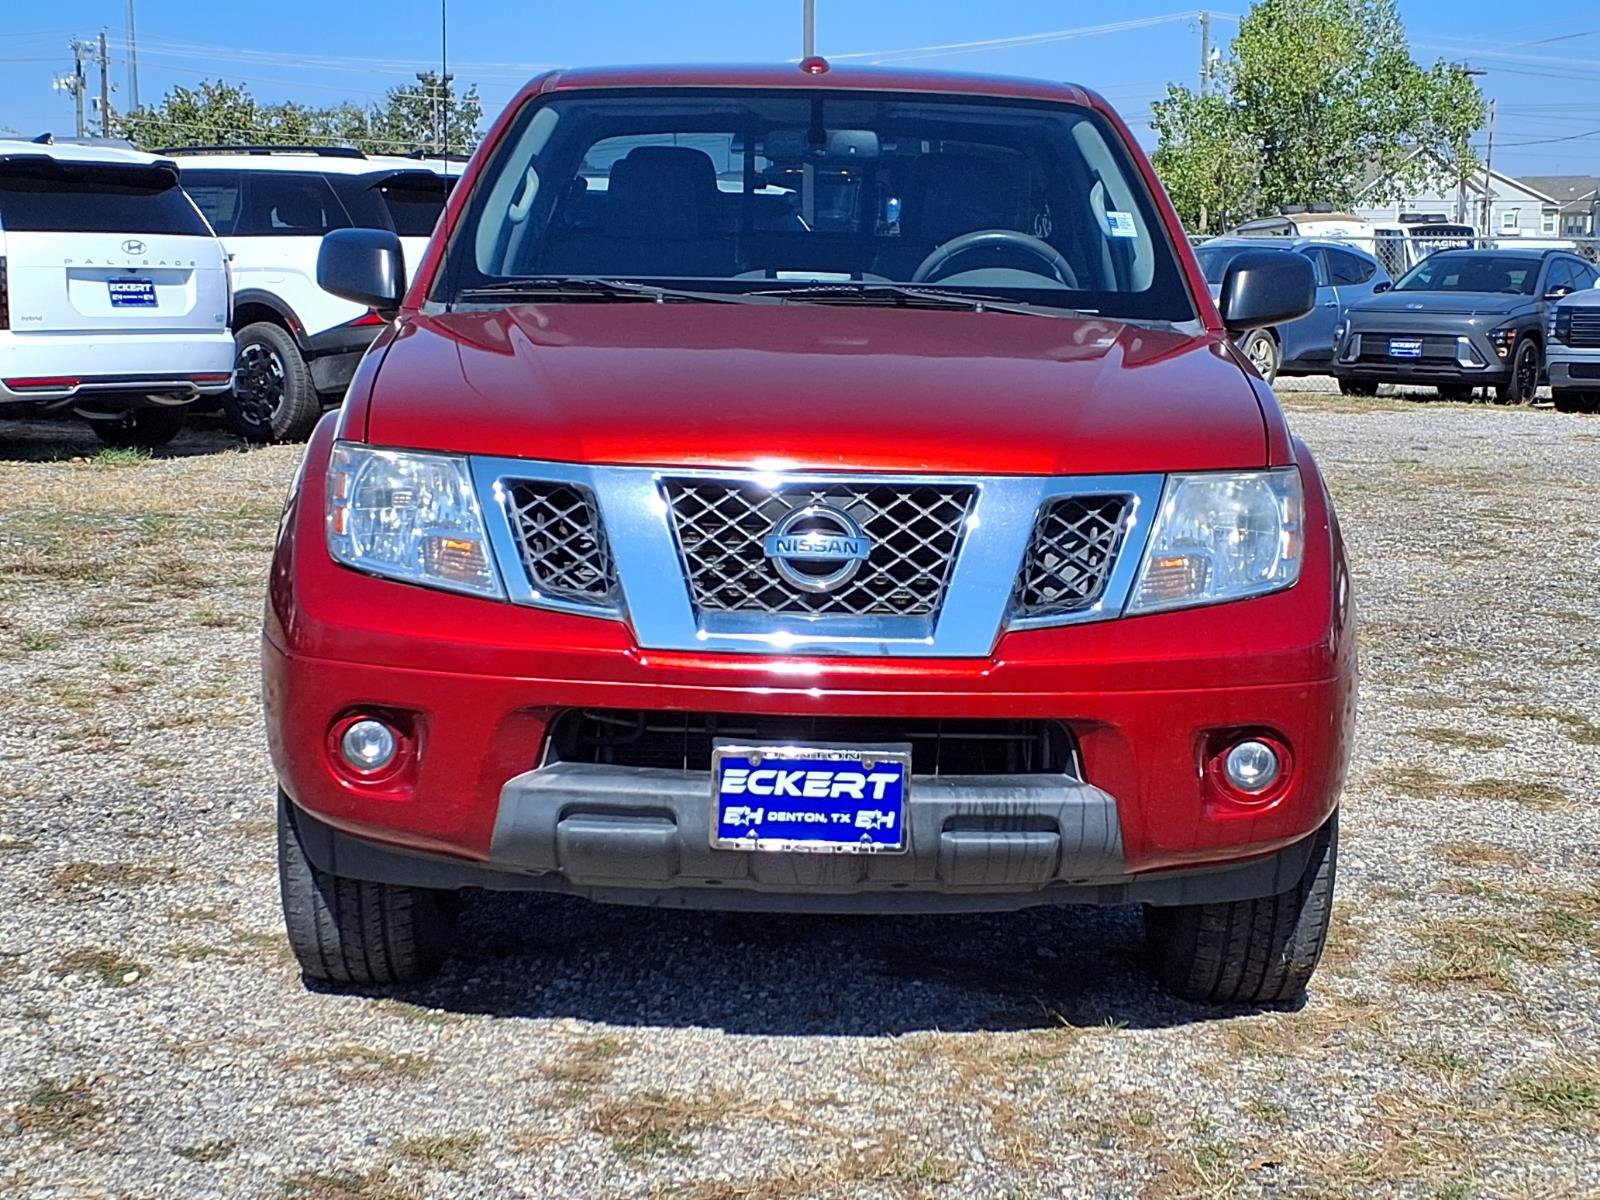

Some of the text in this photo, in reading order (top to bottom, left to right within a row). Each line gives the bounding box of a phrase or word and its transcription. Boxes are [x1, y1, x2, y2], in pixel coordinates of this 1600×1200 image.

[64, 258, 196, 266] PALISADE
[109, 283, 152, 292] ECKERT
[776, 539, 859, 554] NISSAN
[720, 768, 900, 800] ECKERT
[767, 811, 828, 824] DENTON,
[830, 813, 851, 824] TX
